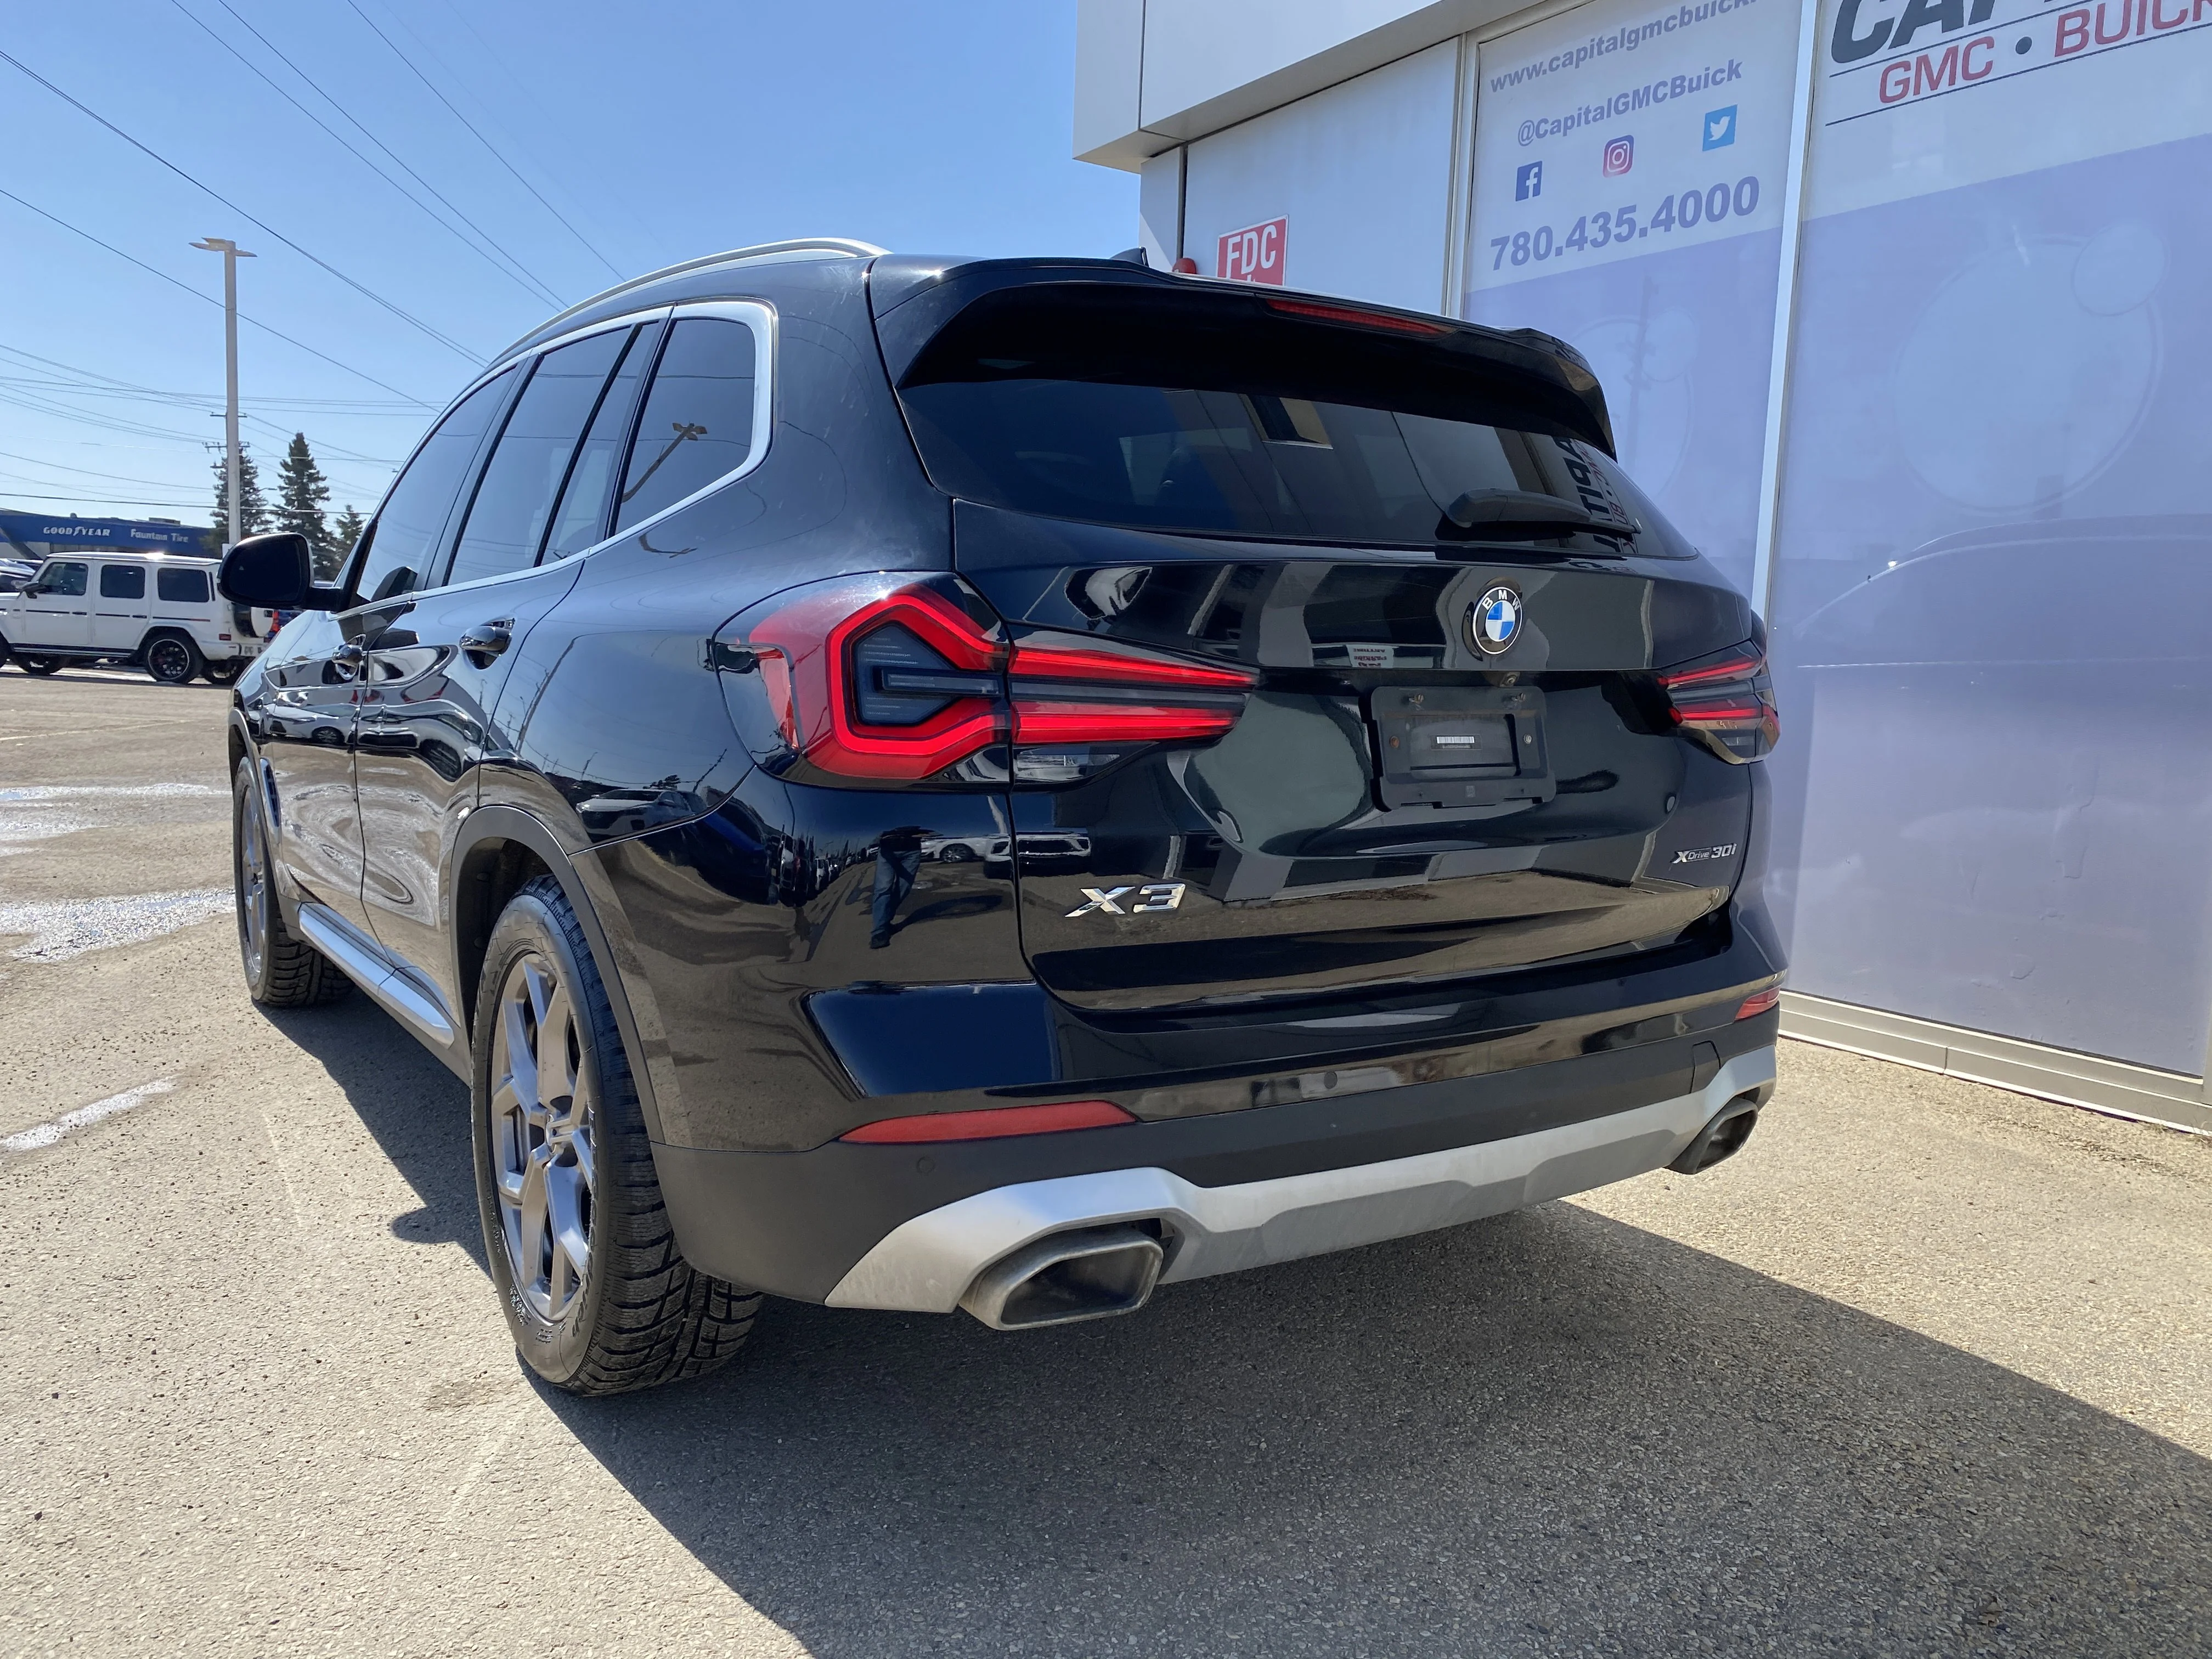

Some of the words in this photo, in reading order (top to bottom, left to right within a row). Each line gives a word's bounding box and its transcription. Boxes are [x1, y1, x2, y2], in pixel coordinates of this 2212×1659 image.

[1878, 36, 1995, 103] GMC
[1517, 58, 1743, 146] @CapitalGMCBuick
[1490, 176, 1760, 270] 780.435.4000
[1226, 224, 1277, 279] FDC
[43, 526, 111, 537] GOODYEAR
[1481, 589, 1521, 611] BMW
[1064, 883, 1186, 918] X3
